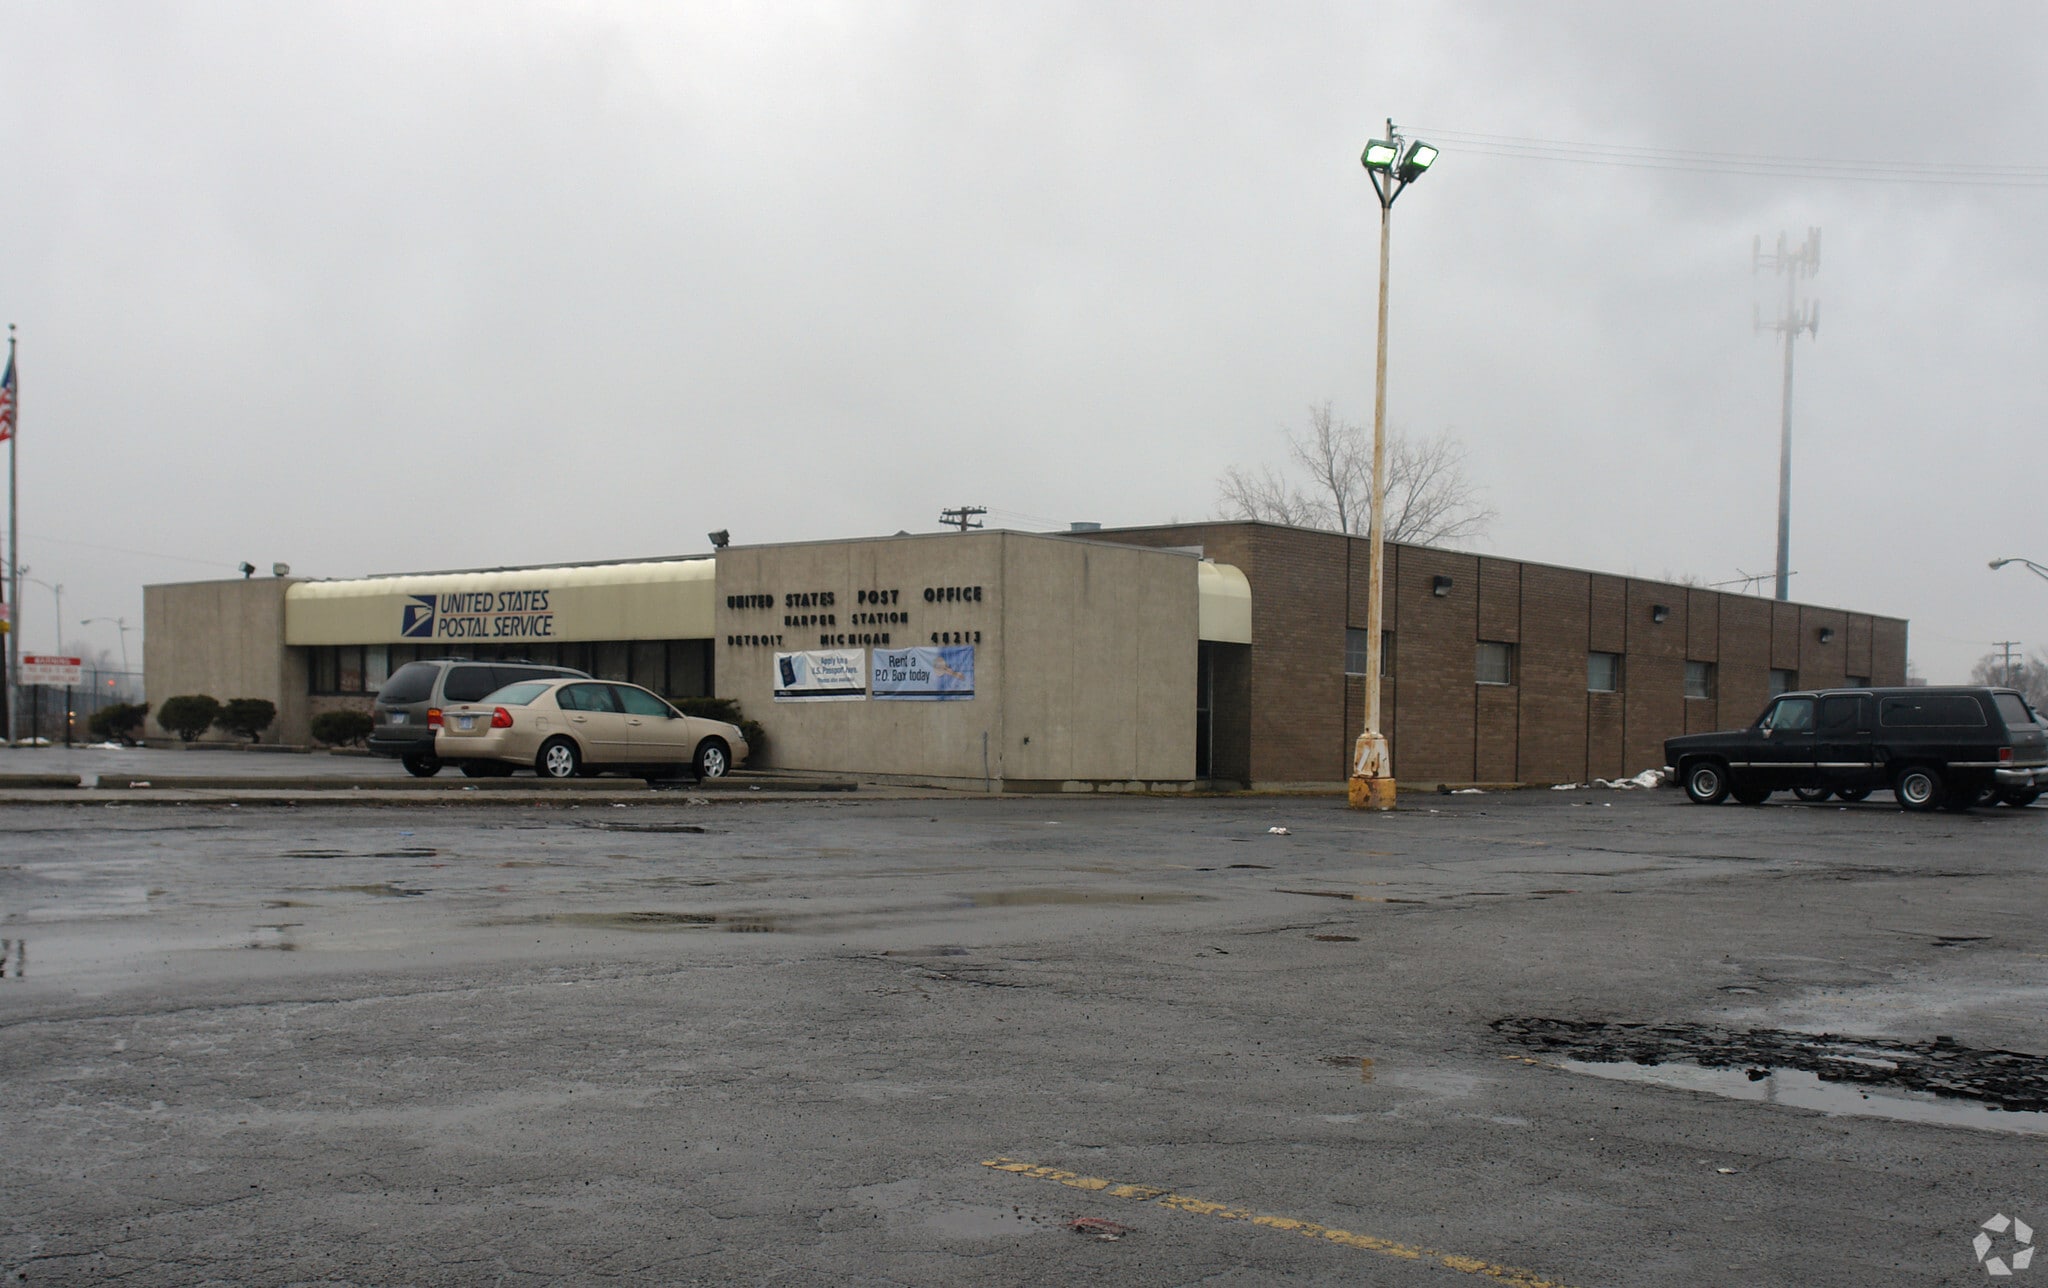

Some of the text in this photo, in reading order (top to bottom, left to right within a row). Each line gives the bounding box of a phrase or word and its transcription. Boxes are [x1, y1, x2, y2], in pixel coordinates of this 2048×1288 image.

[440, 590, 549, 614] UNITED STATES
[727, 586, 982, 610] UNITED STATES POST OFFICE
[437, 615, 553, 637] POSTAL SERVICE
[784, 611, 908, 627] HARPER STATION
[727, 631, 981, 647] DETROIT MICHIGAN 48213
[821, 657, 836, 666] Apply
[888, 655, 916, 667] Rent a
[875, 669, 930, 684] P.O. Box today
